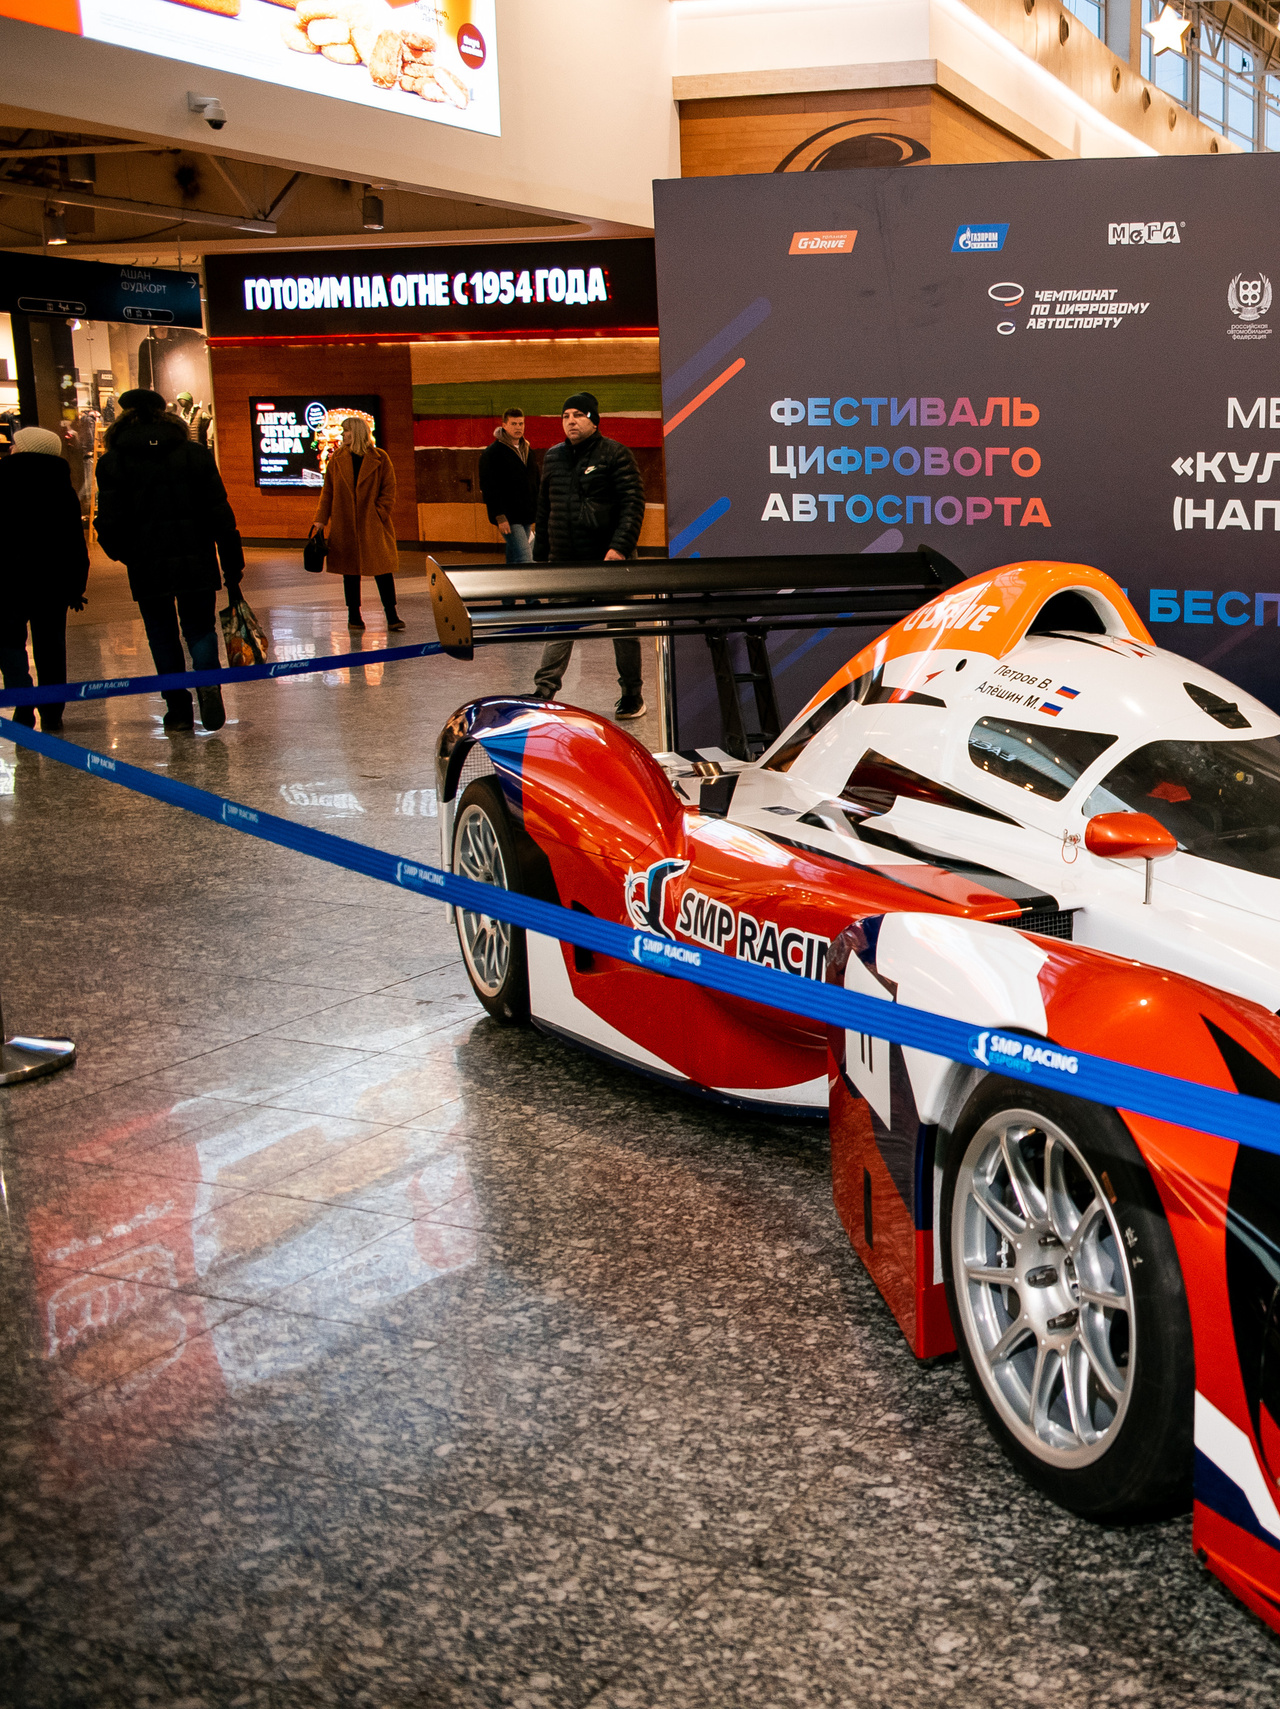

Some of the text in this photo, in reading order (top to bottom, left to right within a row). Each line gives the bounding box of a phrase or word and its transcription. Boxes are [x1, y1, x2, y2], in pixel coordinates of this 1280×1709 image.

[970, 232, 998, 241] ГАЗПРОМ
[120, 268, 151, 281] АШАН
[120, 281, 168, 295] ФУДКОРТ
[244, 267, 608, 310] ГОТОВИМ НА ОГНЕ С 1954 ГОДА
[1034, 289, 1118, 302] ЧЕМПИОНАТ
[1030, 302, 1150, 316] ПО ЦИФРОВОМУ
[1026, 317, 1123, 330] АВТОСПОРТУ
[256, 412, 297, 425] АНГУС
[770, 397, 1040, 427] ФЕСТИВАЛЬ
[260, 425, 310, 438] ЧЕТЫРЕ
[260, 438, 304, 453] СЫРА
[769, 445, 1042, 479] ЦИФРОВОГО
[760, 493, 1052, 527] АВТОСПОРТА
[88, 680, 130, 691] SMP RACING
[994, 664, 1053, 691] Петров В.
[975, 681, 1040, 710] Алёшин М.
[403, 864, 418, 877] SMP
[418, 868, 445, 887] RACING
[675, 888, 735, 953] SMP
[642, 937, 701, 967] SMP RACING
[988, 1050, 1033, 1073] ESPORTS
[989, 1035, 1079, 1074] SMP RACING
